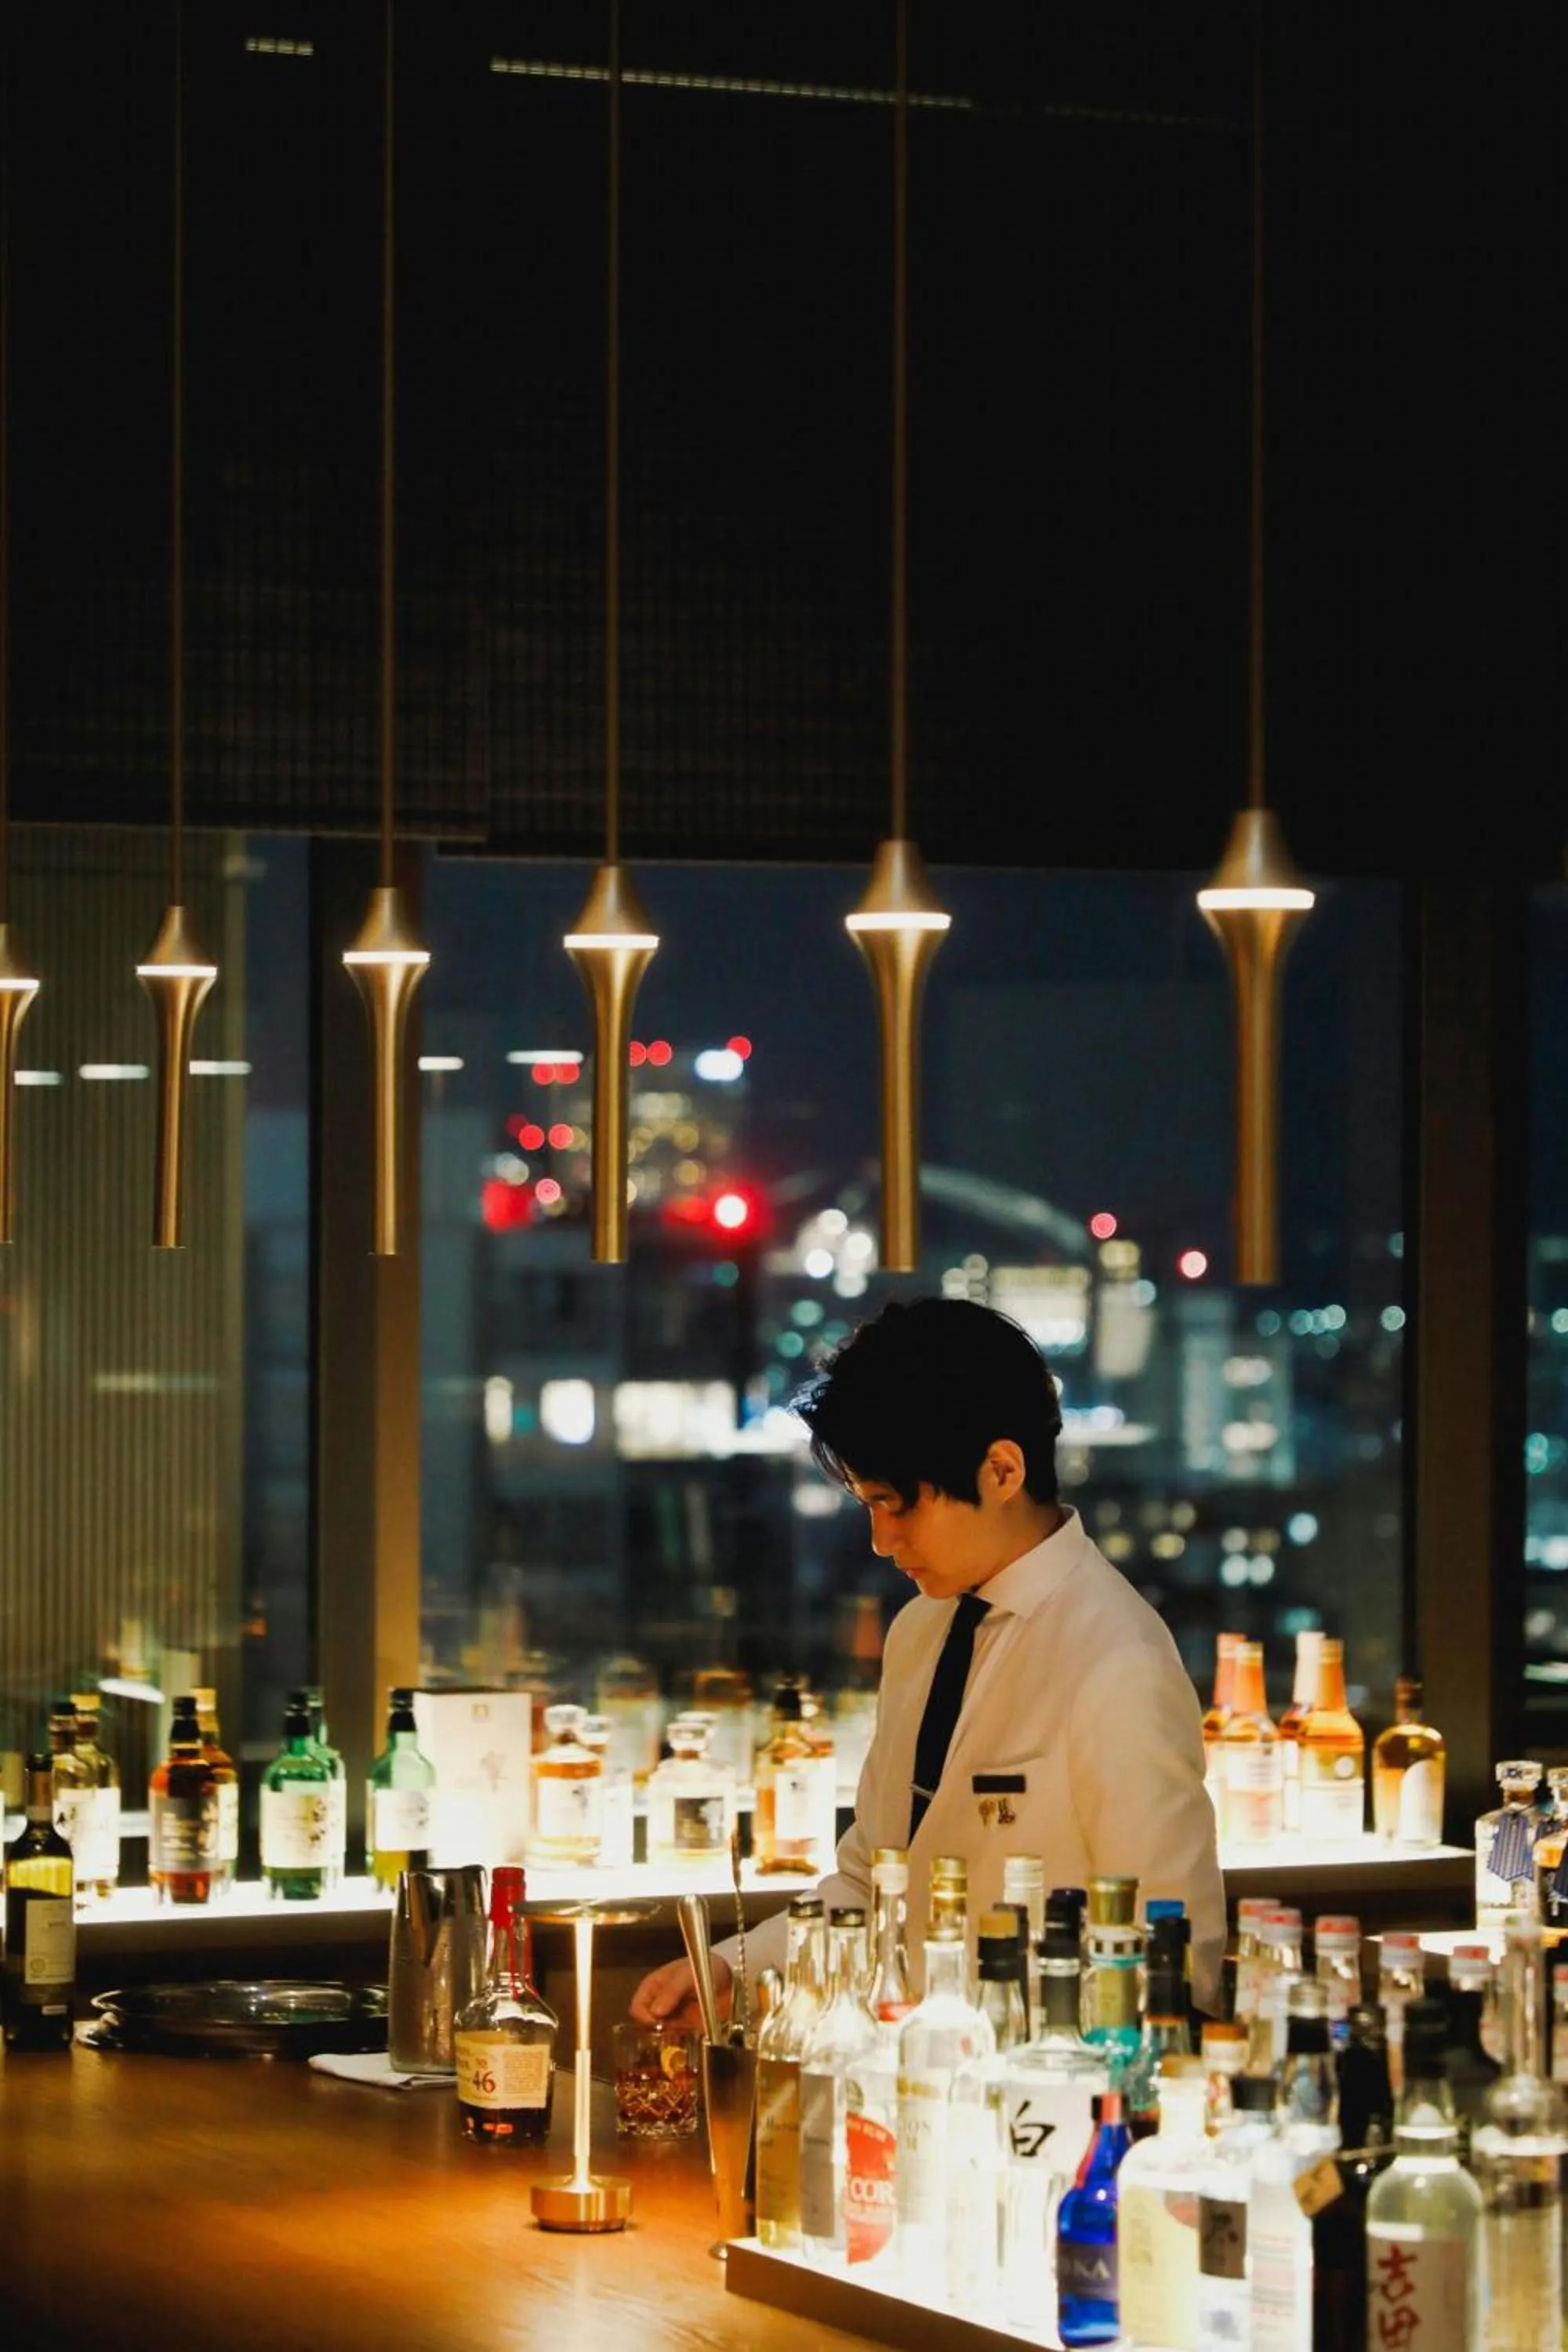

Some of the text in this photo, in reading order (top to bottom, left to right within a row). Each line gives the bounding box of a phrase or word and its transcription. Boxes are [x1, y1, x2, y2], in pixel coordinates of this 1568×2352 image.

[472, 2071, 496, 2094] 46
[1008, 2100, 1057, 2158] 白
[1376, 2242, 1421, 2350] 吉田
